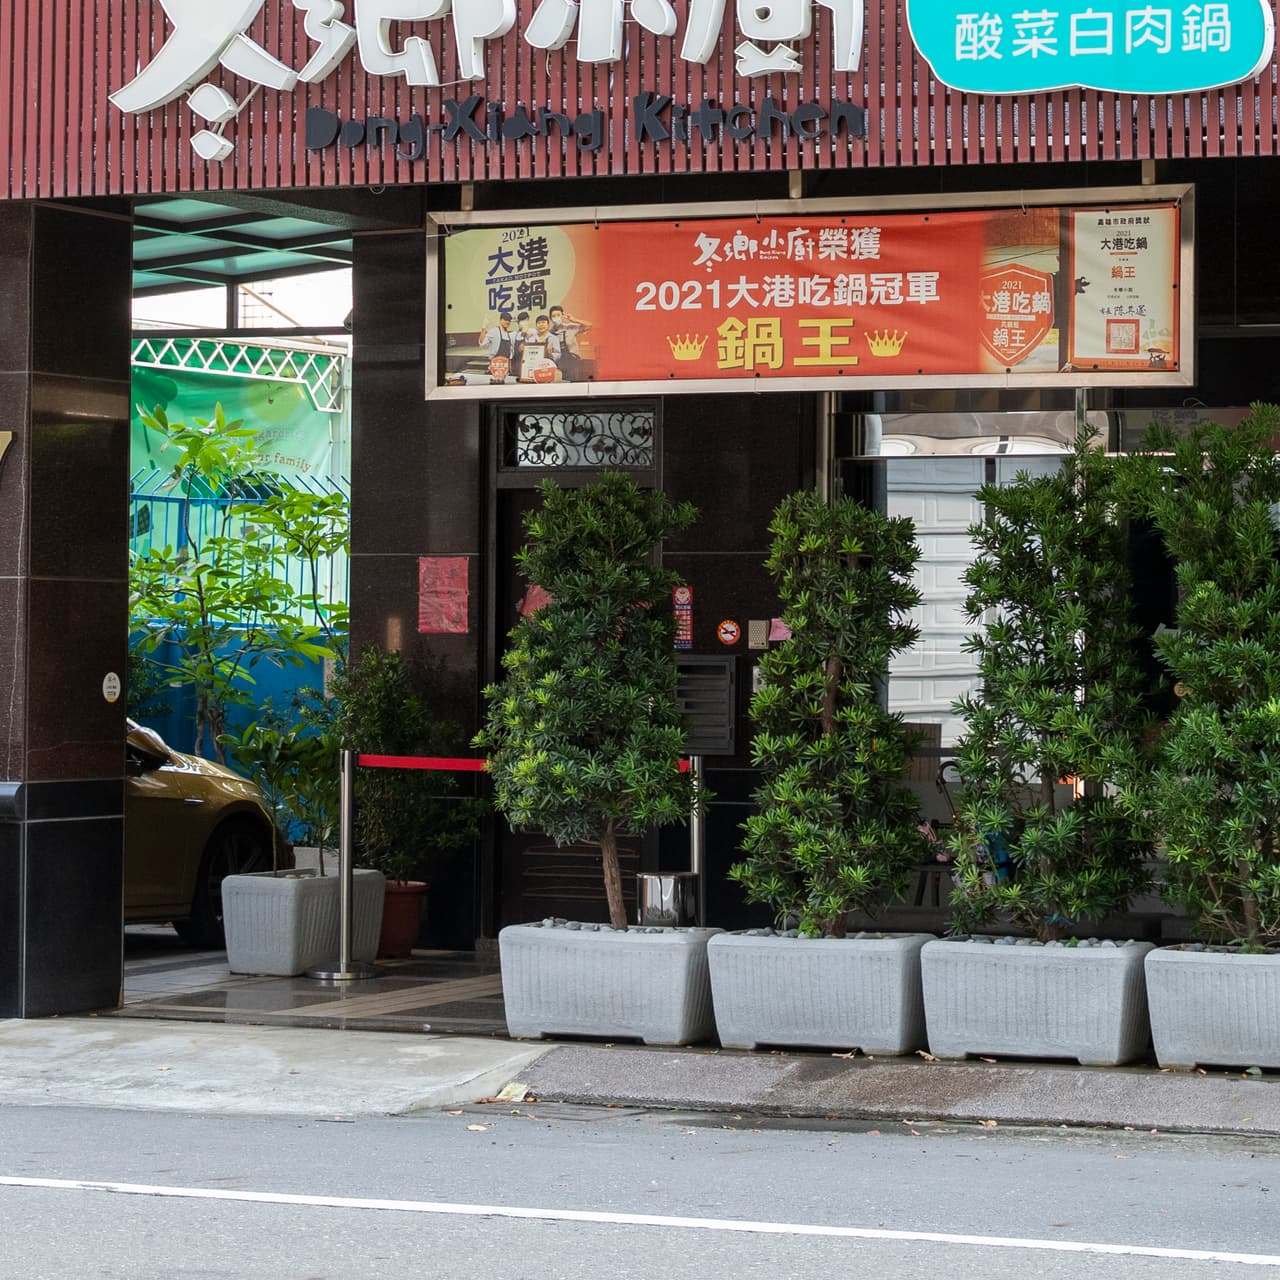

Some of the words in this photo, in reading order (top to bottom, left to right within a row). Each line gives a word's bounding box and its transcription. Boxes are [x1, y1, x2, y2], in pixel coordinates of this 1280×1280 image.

[955, 2, 1232, 62] 酸菜白肉鍋
[305, 95, 604, 161] Dong-Xiang
[632, 91, 866, 145] Kitchen
[502, 226, 531, 243] 2021
[1101, 237, 1148, 250] 大港吃鍋
[488, 236, 548, 277] 大港
[1002, 281, 1022, 289] 2021
[1111, 266, 1136, 279] 鍋王
[488, 279, 547, 313] 吃鍋
[635, 272, 941, 311] 2021大港吃鍋冠軍
[716, 317, 860, 371] 鍋王
[993, 328, 1026, 347] 鍋王
[274, 452, 312, 473] family
